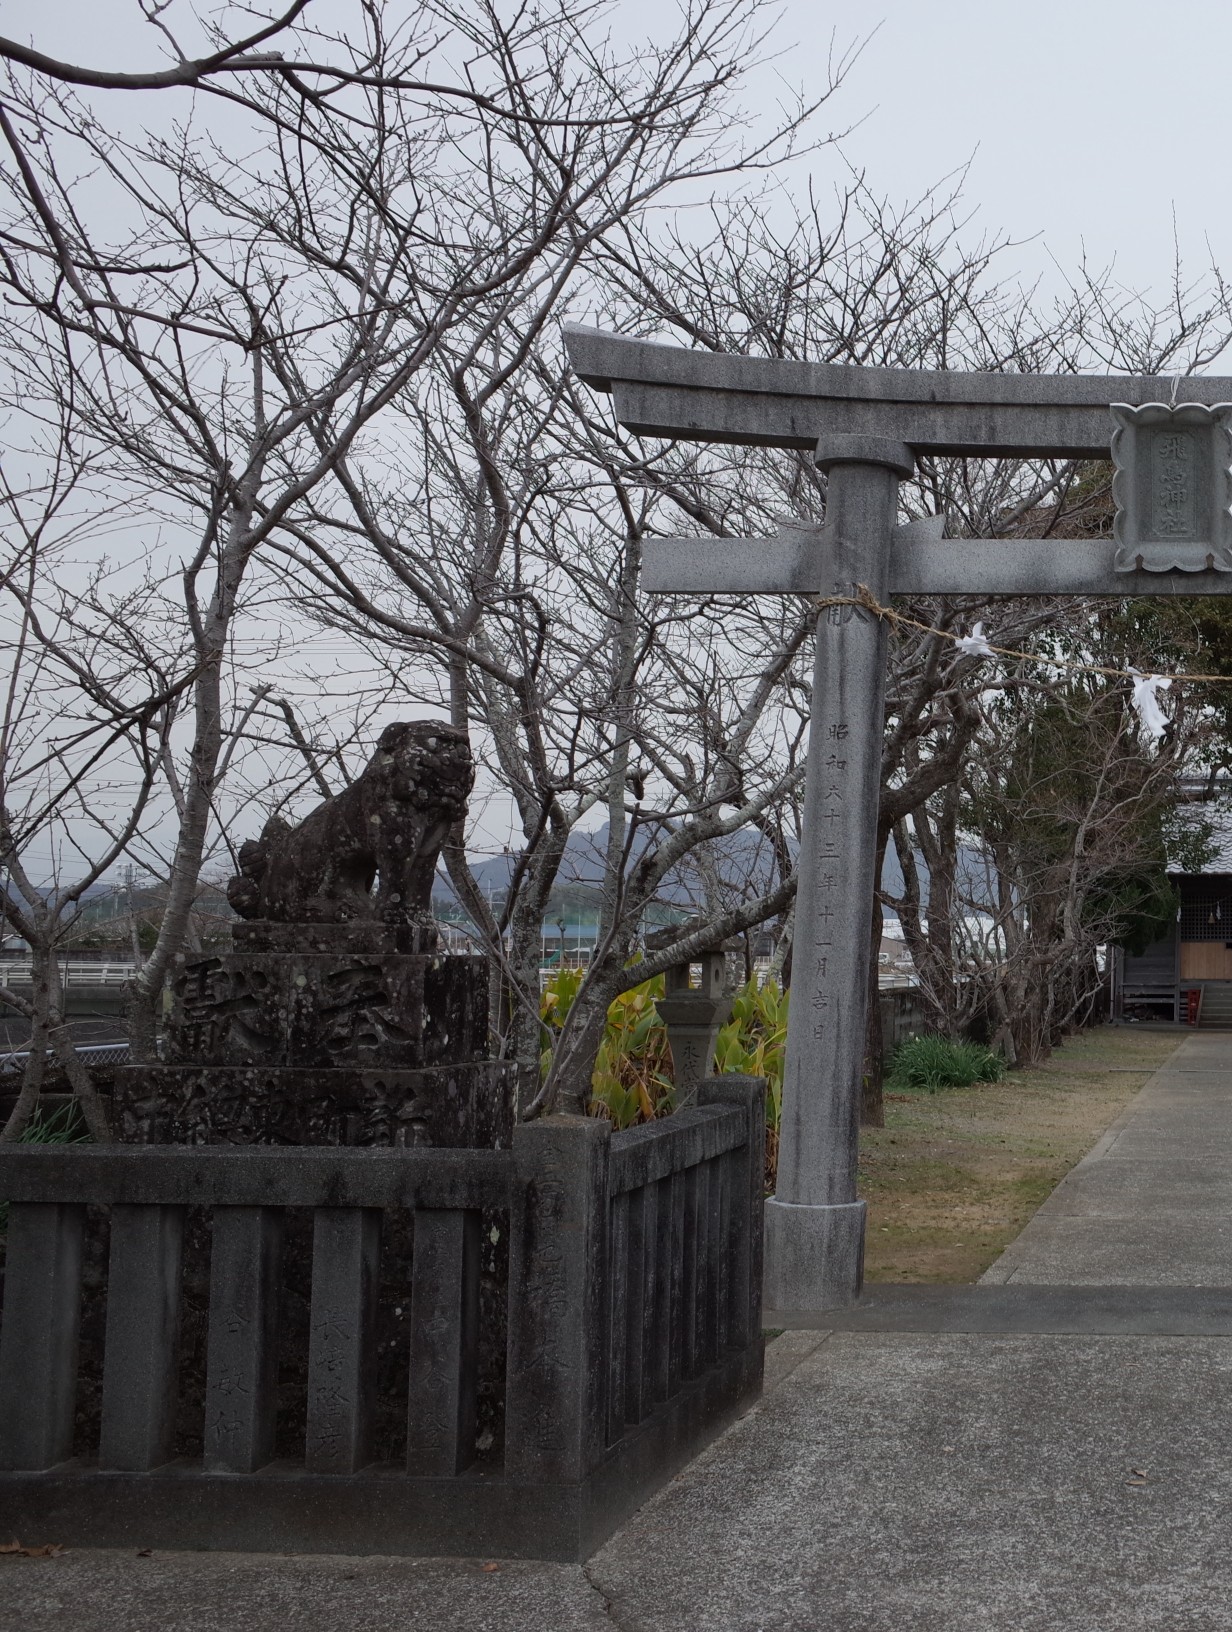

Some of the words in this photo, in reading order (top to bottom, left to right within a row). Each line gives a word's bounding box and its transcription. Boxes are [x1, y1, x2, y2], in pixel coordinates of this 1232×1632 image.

[811, 724, 849, 1041] 昭和六十三年十一月吉日
